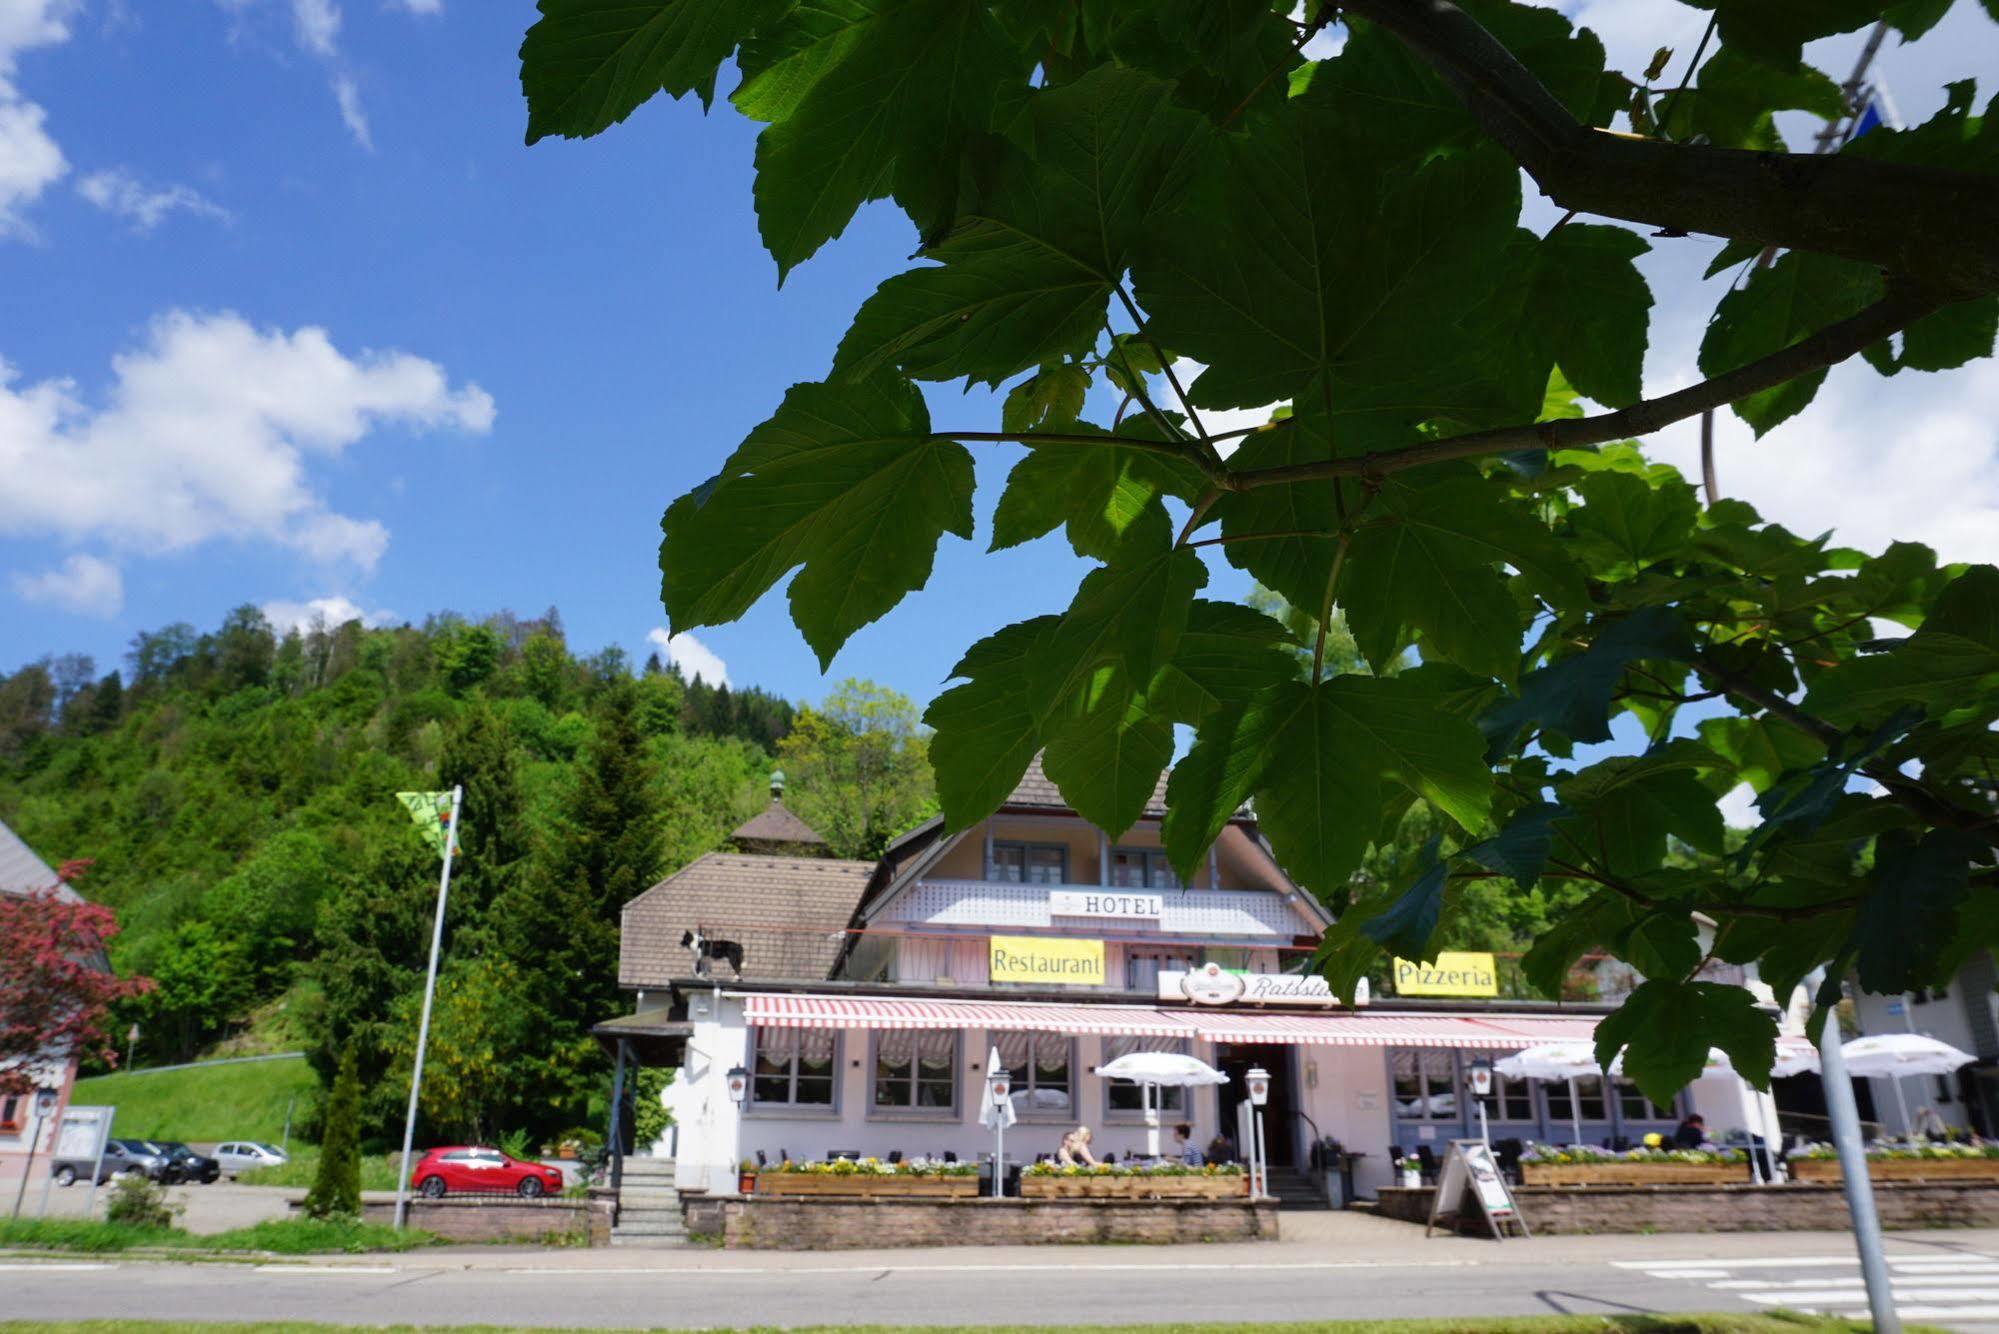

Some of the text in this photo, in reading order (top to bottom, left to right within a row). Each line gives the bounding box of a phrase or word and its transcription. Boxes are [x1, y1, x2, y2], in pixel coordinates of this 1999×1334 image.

[1086, 897, 1159, 915] HOTEL
[994, 950, 1099, 975] Restaurant
[1400, 964, 1492, 986] Pizzeria
